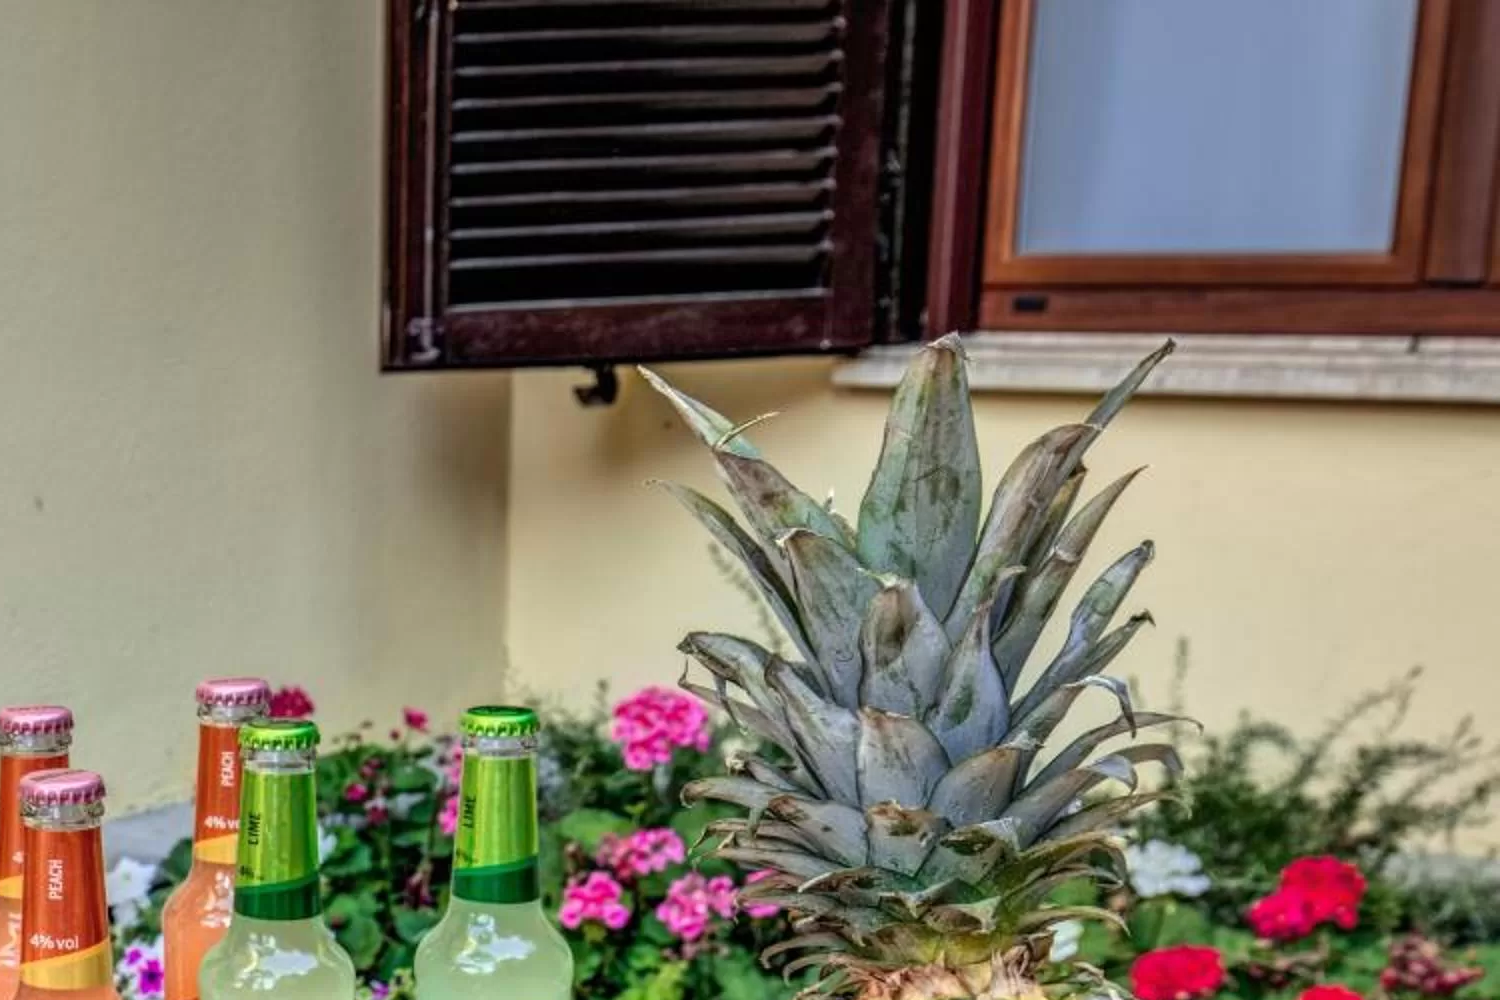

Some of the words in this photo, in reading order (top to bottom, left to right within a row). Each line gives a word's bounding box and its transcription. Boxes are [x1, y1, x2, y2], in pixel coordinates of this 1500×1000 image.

[47, 859, 63, 900] PEACH
[30, 932, 54, 949] 4%
[56, 935, 79, 950] vol
